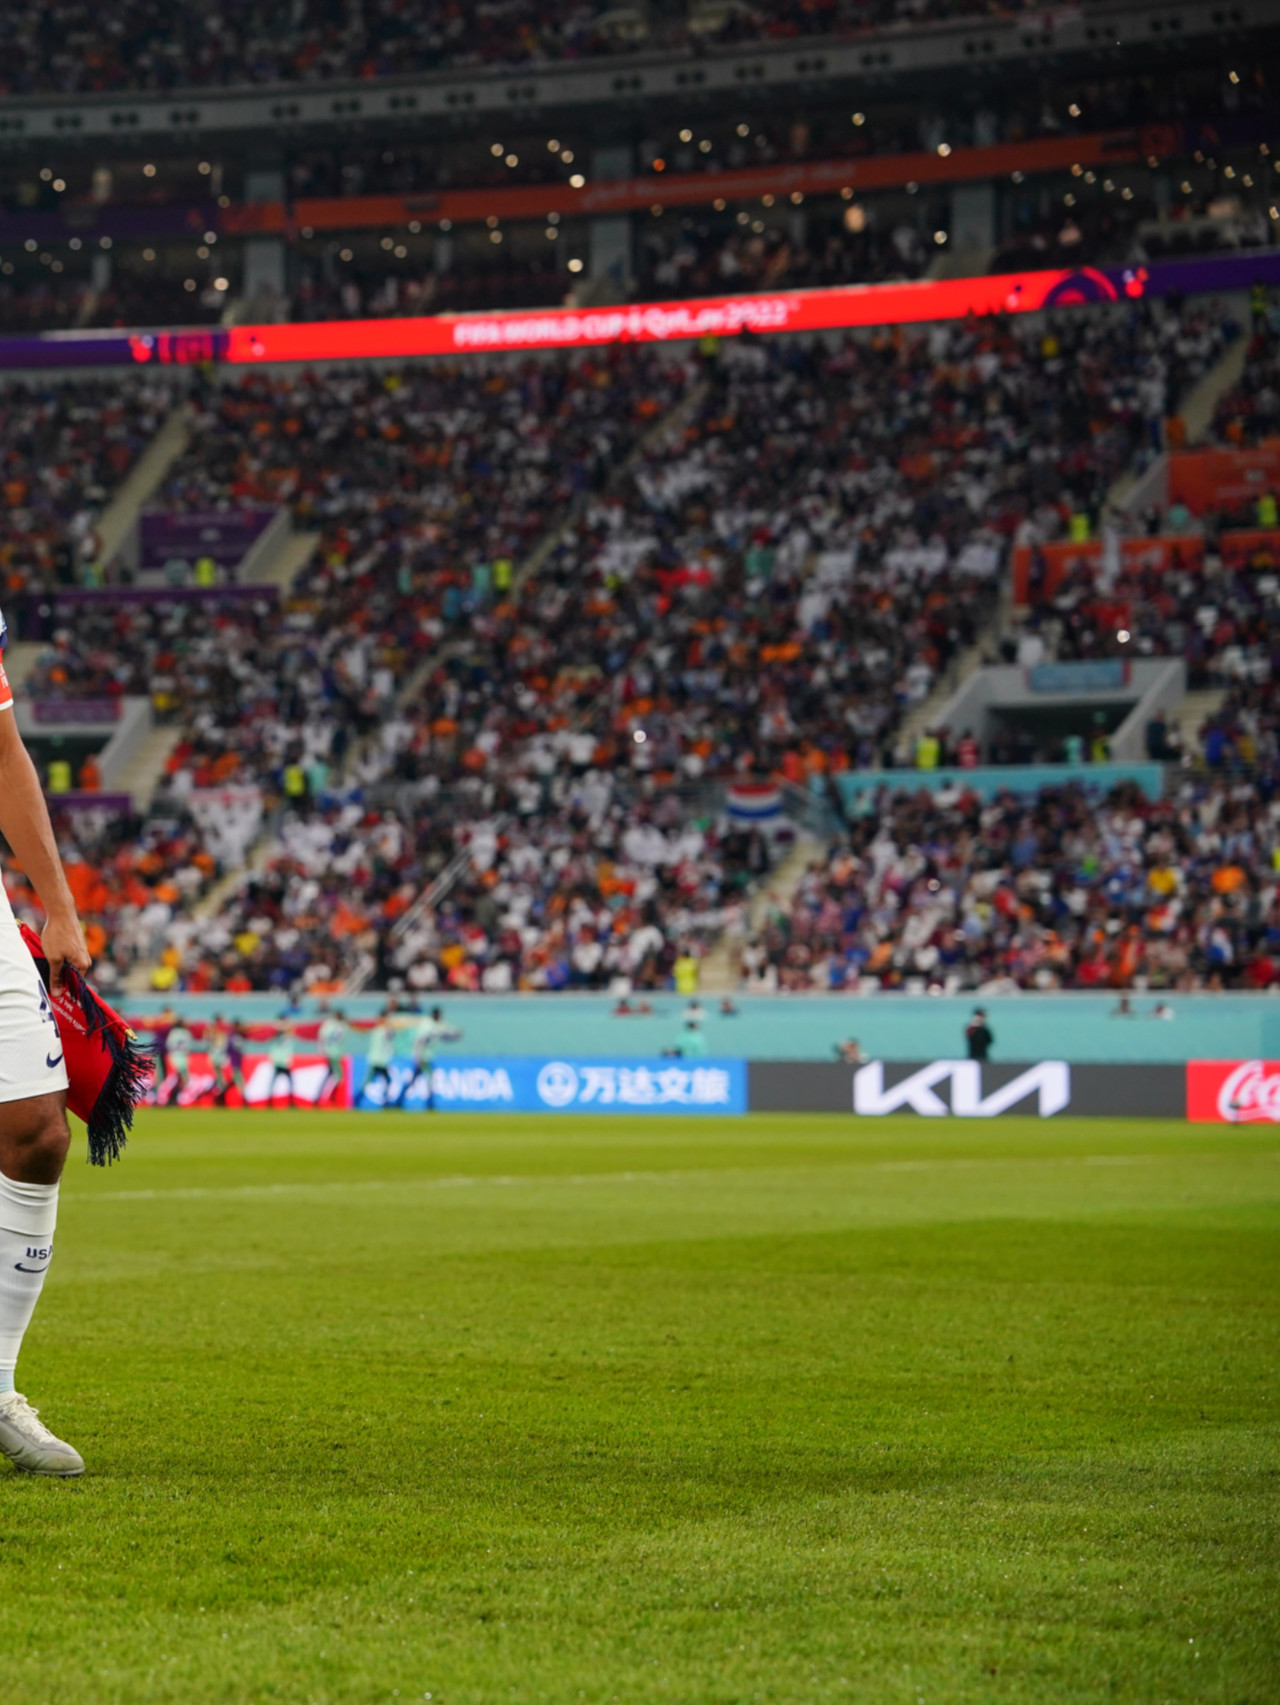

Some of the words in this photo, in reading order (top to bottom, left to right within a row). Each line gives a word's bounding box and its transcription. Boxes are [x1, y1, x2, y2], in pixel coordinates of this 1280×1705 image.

[504, 312, 581, 344] WORLD
[583, 307, 622, 339] CUP
[579, 1066, 730, 1103] 万达文旅
[853, 1060, 1070, 1117] KIA
